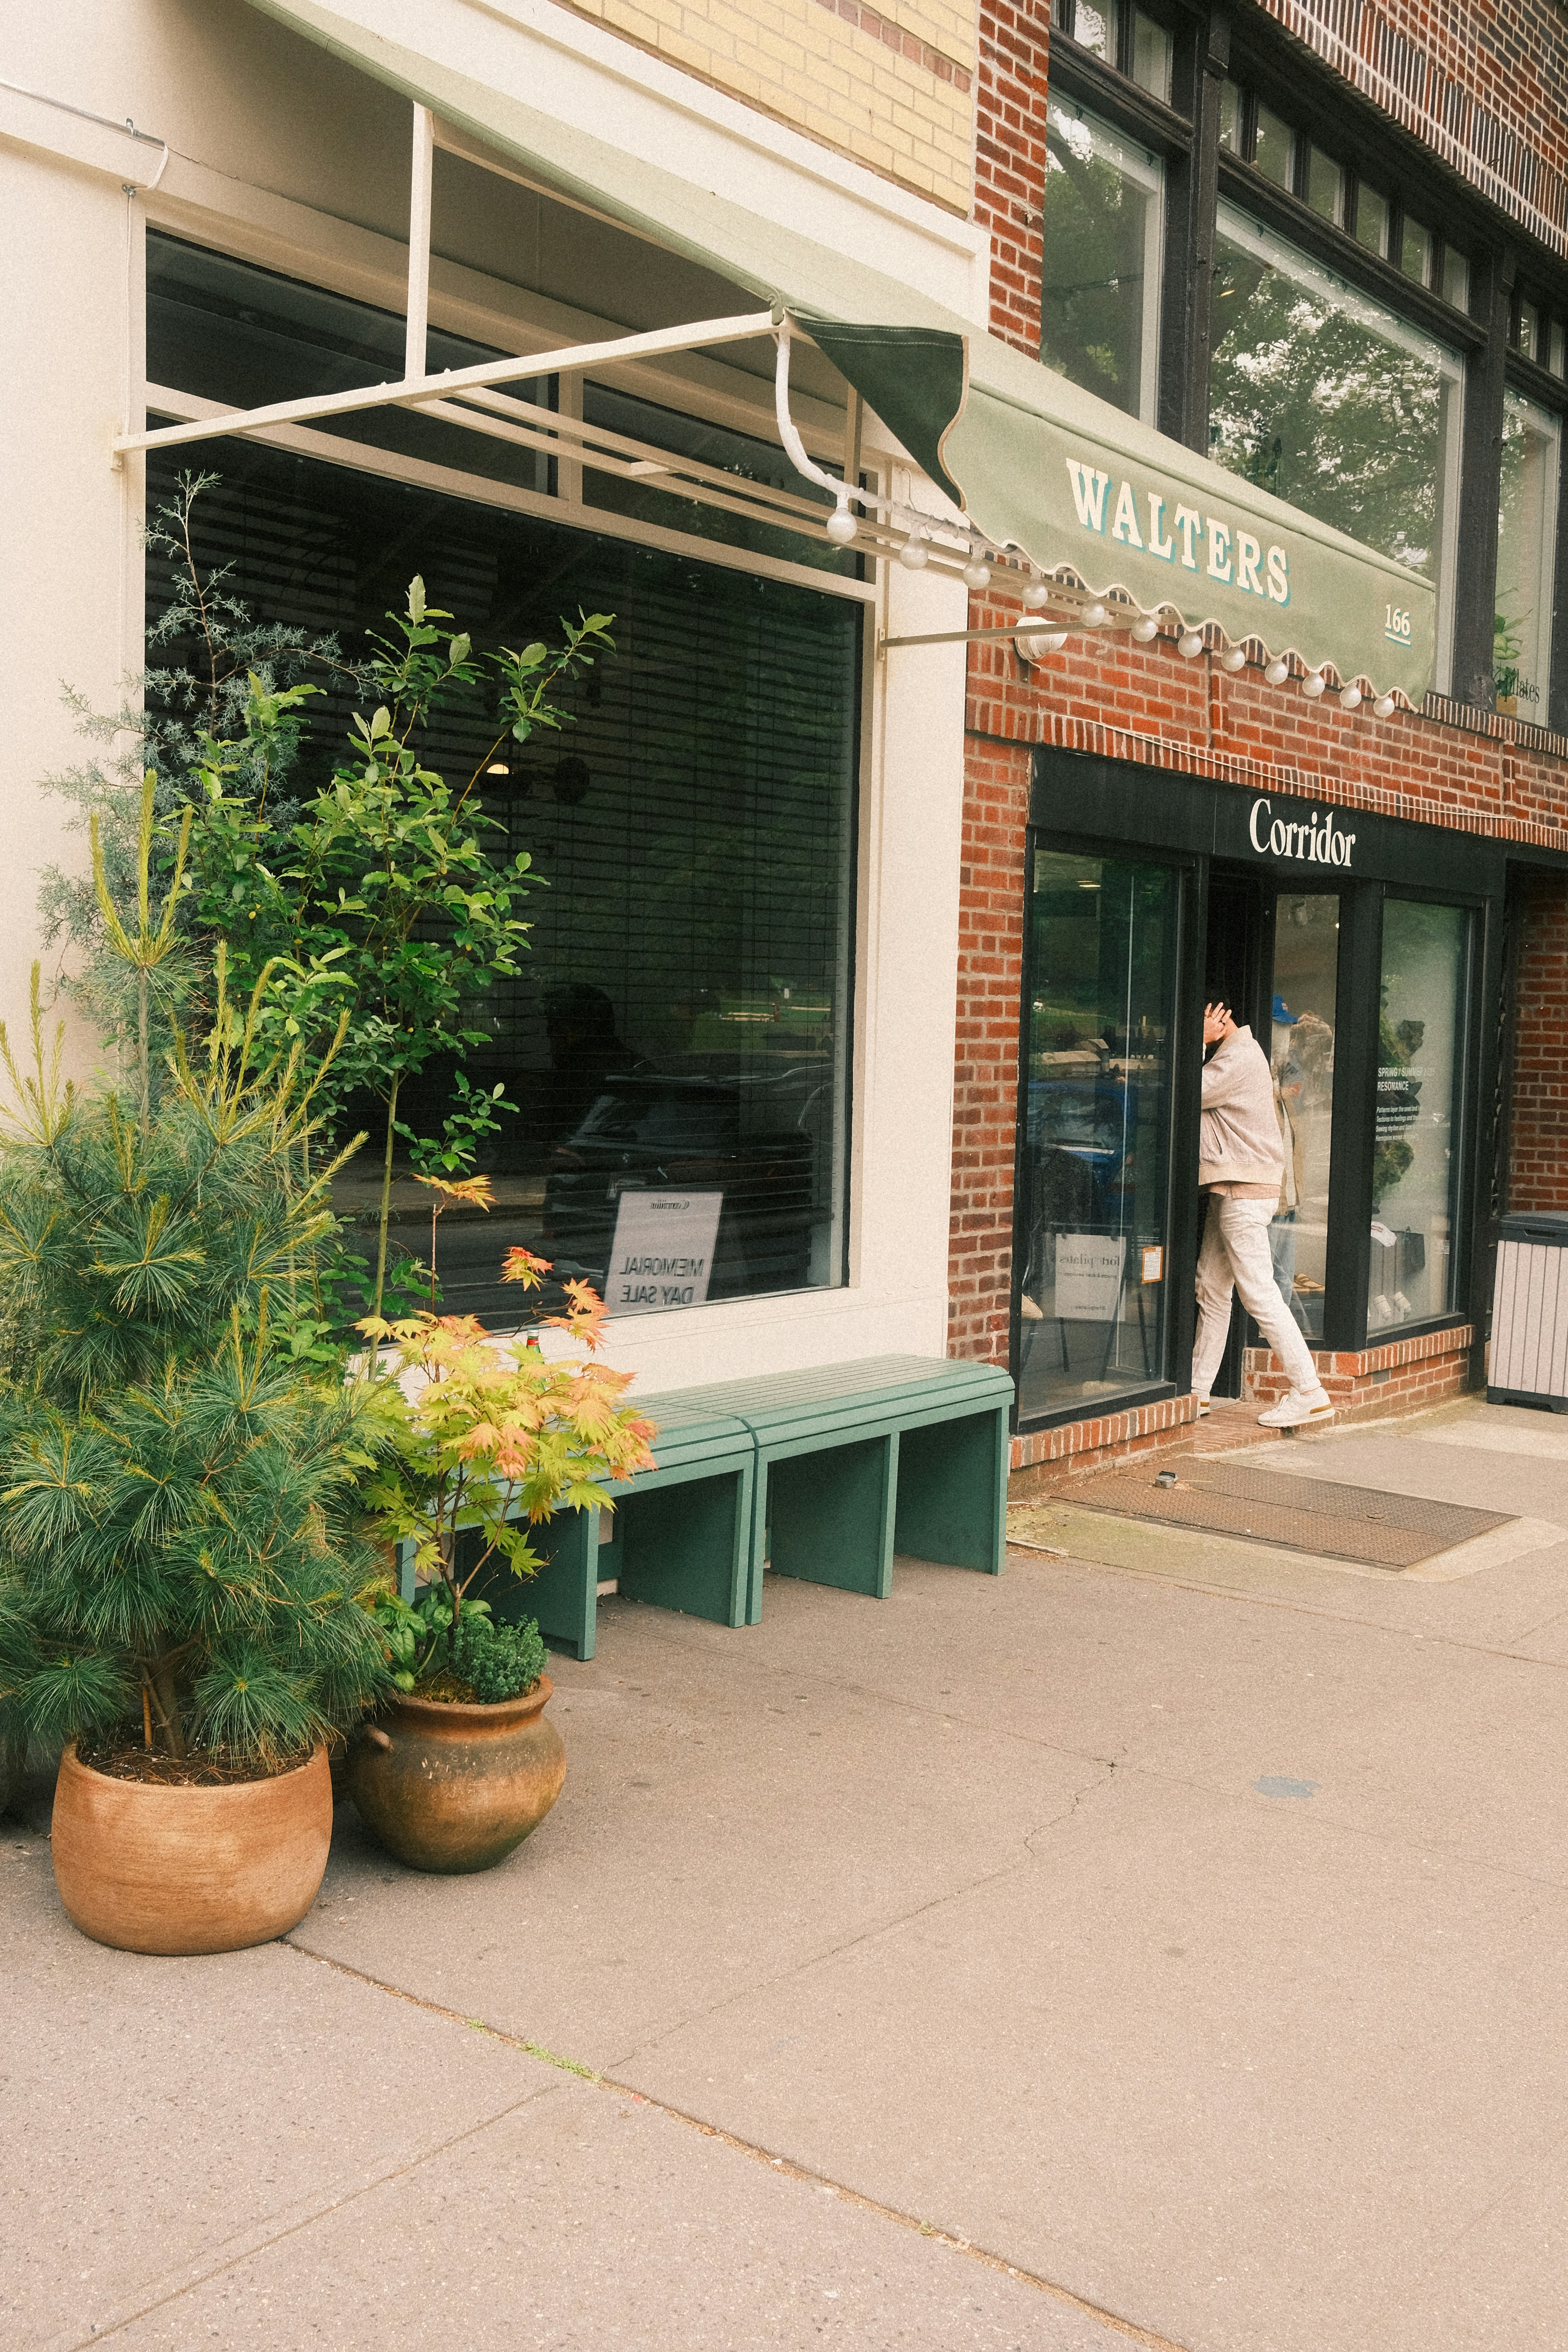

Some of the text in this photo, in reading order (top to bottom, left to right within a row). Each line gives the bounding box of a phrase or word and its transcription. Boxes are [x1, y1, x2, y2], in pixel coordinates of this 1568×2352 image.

[1066, 458, 1290, 606] WALTERS
[1385, 604, 1410, 637] 166
[1504, 668, 1540, 703] pilates
[1250, 798, 1356, 867] Corridor
[1377, 1081, 1409, 1091] RESONANCE
[1378, 1067, 1397, 1077] SPRING
